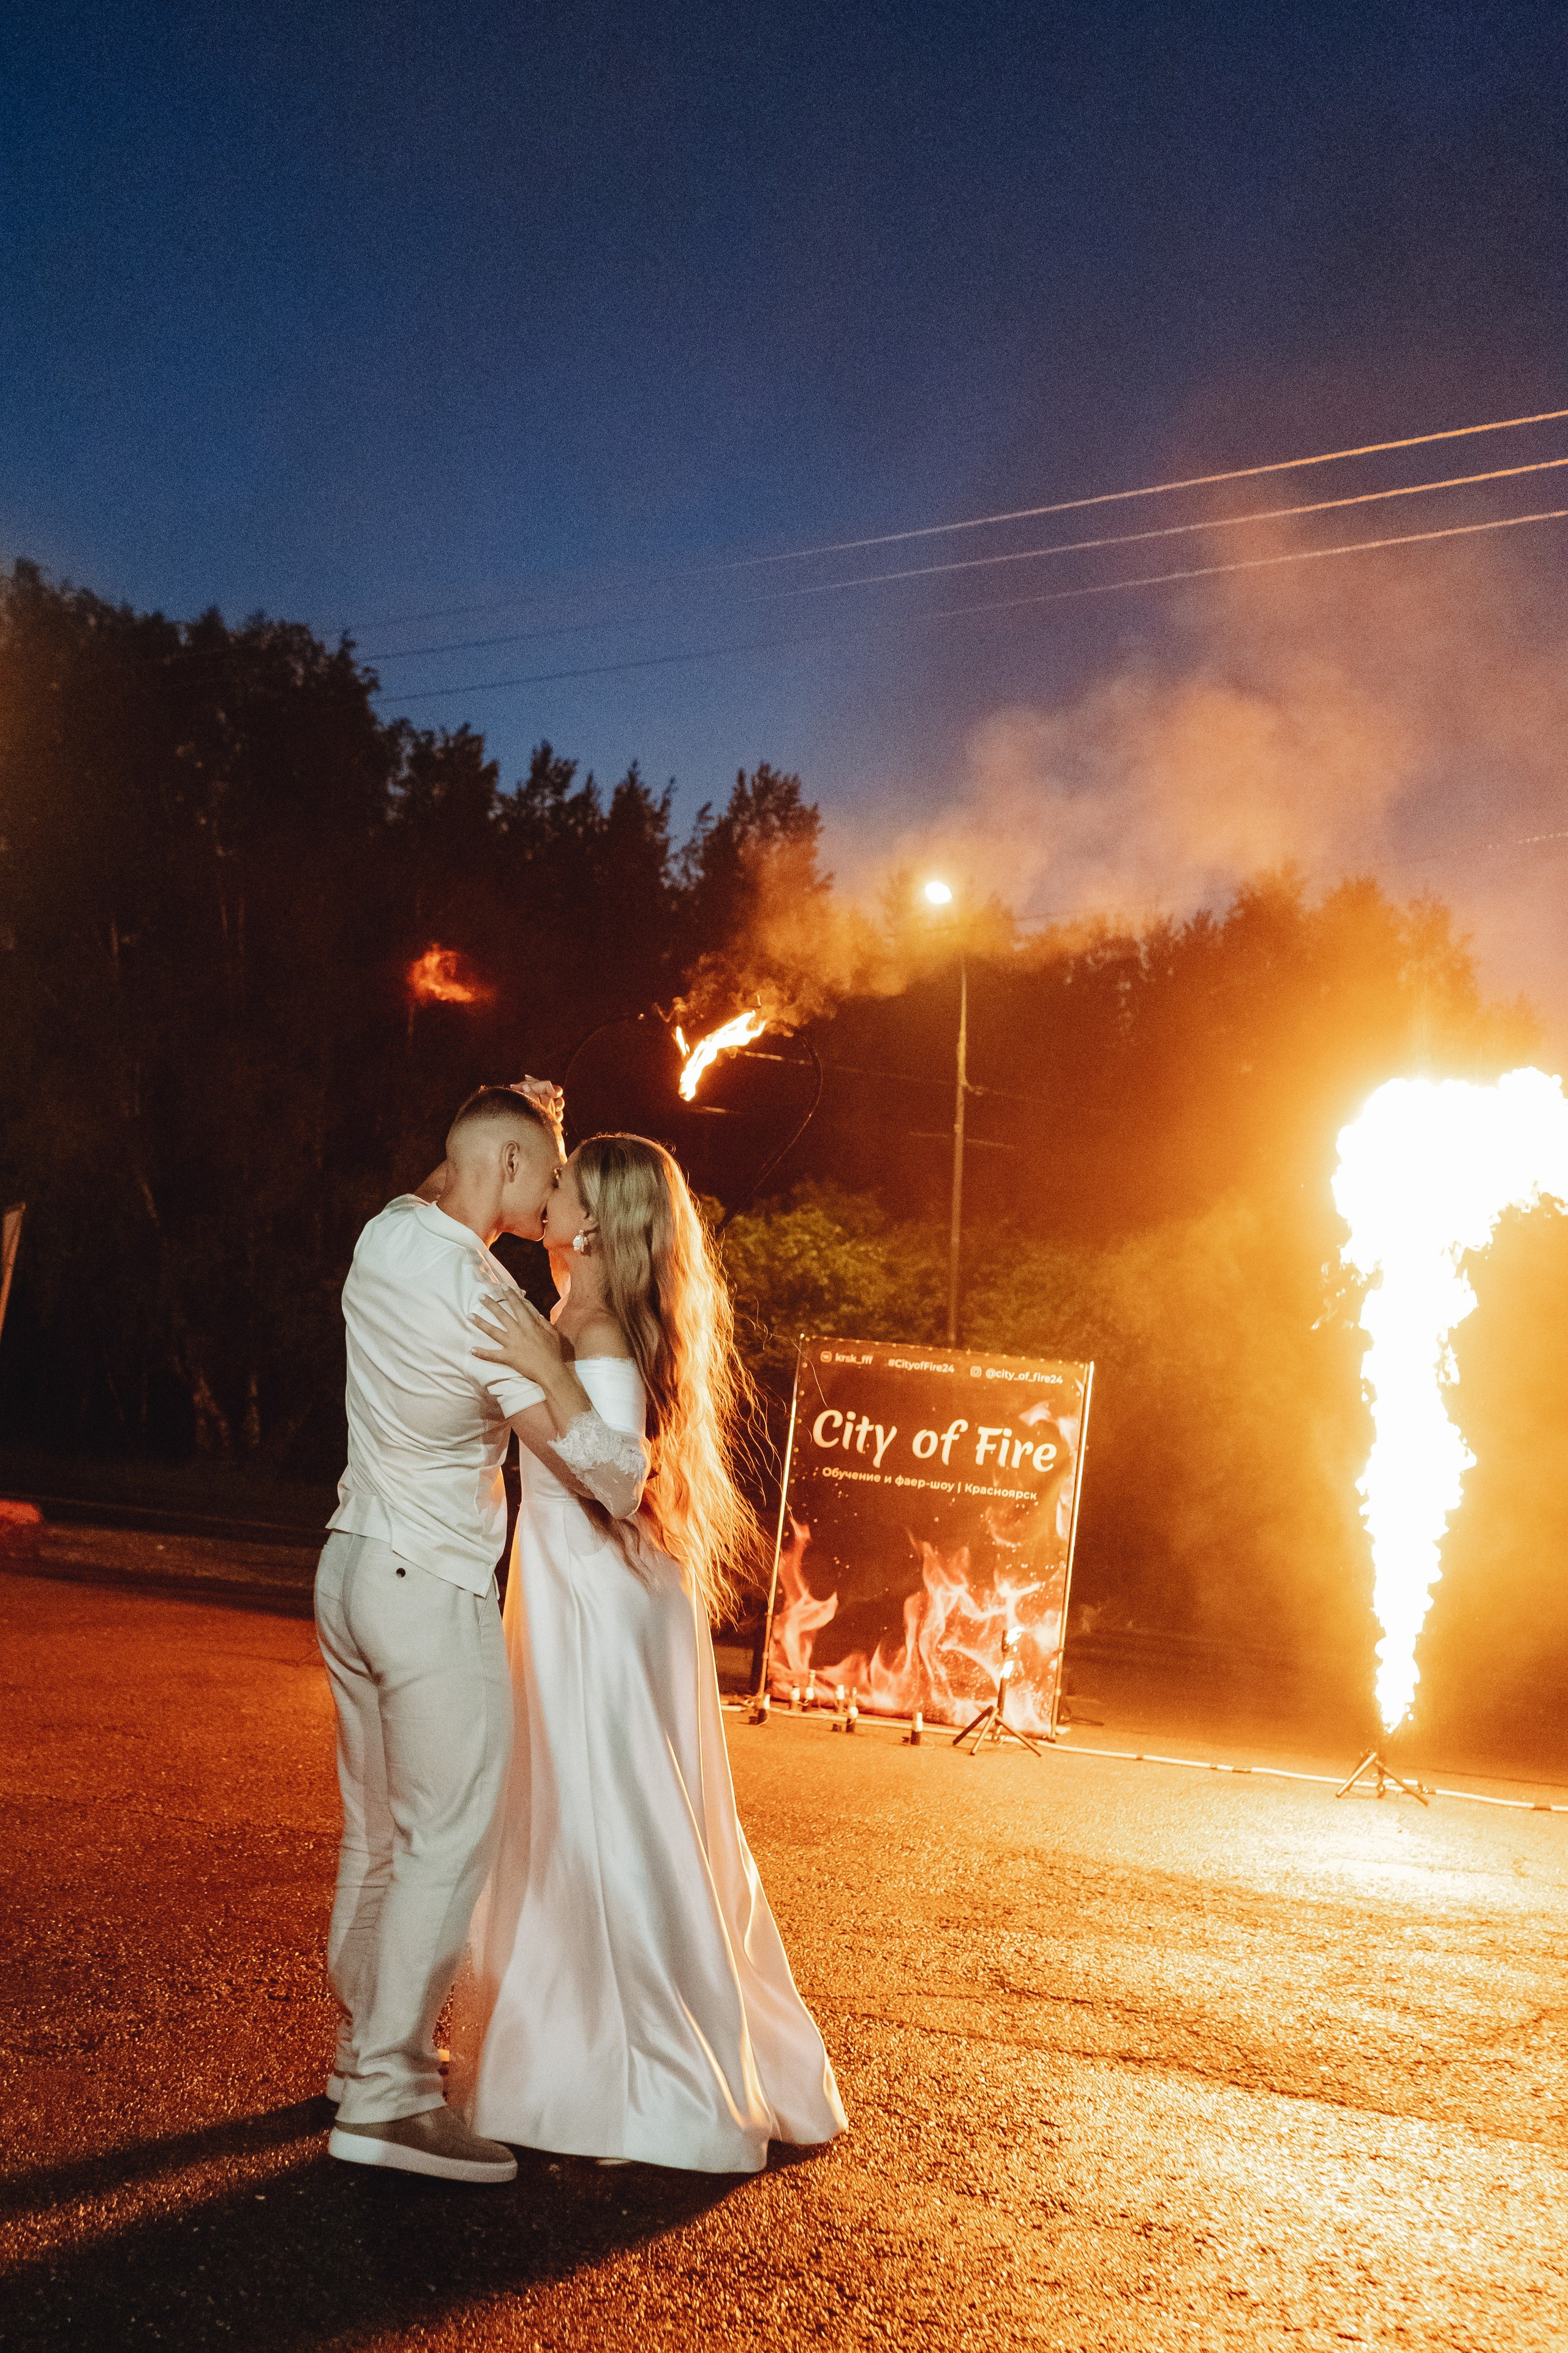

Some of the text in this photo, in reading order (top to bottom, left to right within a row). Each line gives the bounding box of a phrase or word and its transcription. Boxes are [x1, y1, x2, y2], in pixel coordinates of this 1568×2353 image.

[835, 1353, 873, 1365] krsk_fff
[888, 1358, 955, 1373] #CityofFire24
[986, 1367, 1063, 1384] @city_of_fire24
[812, 1410, 1058, 1472] City of Fire
[822, 1467, 881, 1483] Обучение
[884, 1475, 892, 1484] и
[894, 1475, 955, 1493] фаер-шоу
[964, 1482, 1038, 1501] Красноярск
